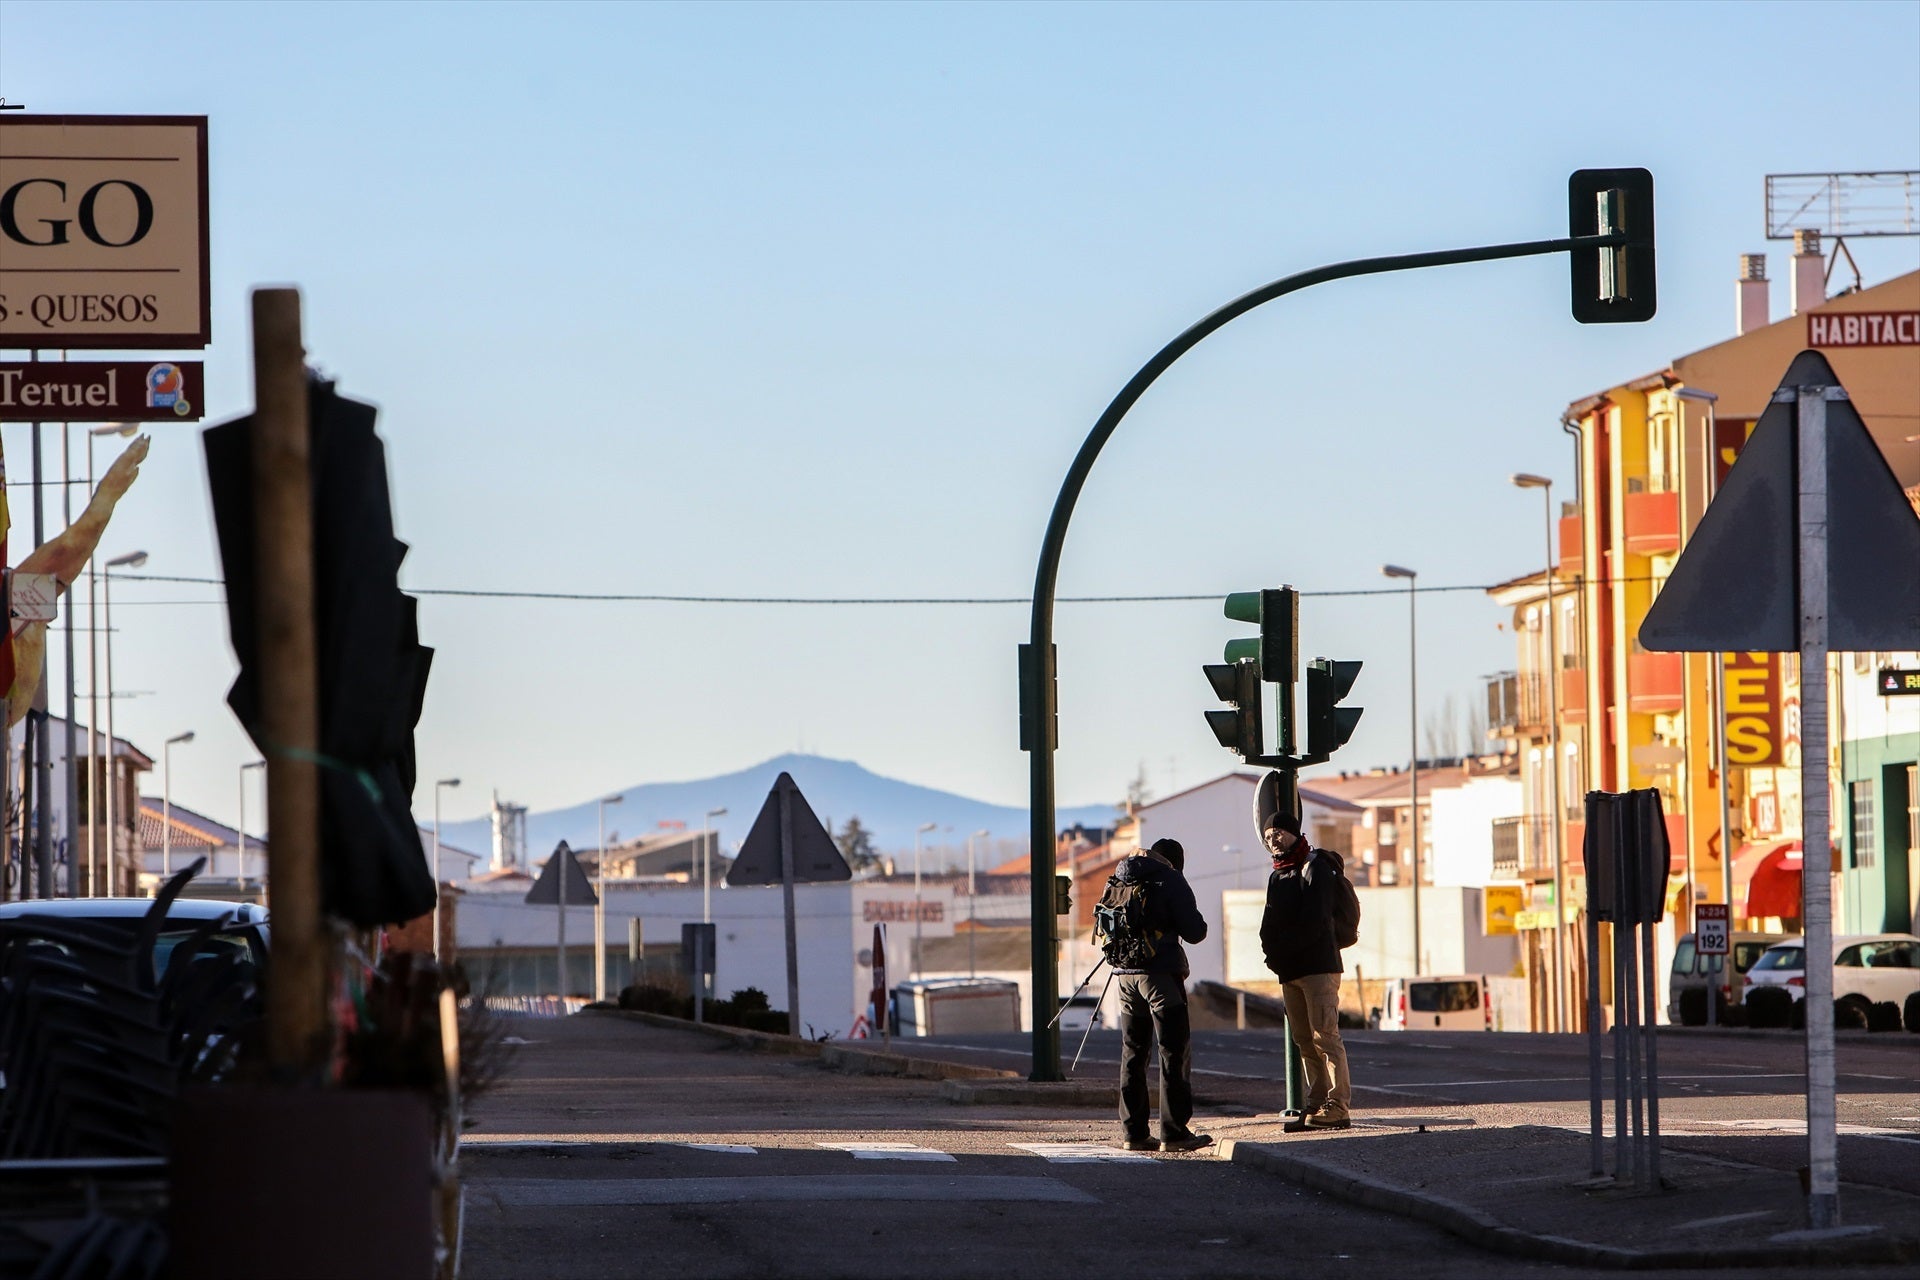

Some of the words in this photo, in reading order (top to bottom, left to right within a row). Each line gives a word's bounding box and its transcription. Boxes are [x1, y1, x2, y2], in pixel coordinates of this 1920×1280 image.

[0, 178, 154, 247] GO
[31, 294, 158, 328] QUESOS
[1811, 314, 1920, 345] HABITACI
[0, 368, 118, 407] Teruel
[1698, 907, 1726, 918] N-234
[1706, 923, 1721, 931] km
[1701, 934, 1725, 949] 192
